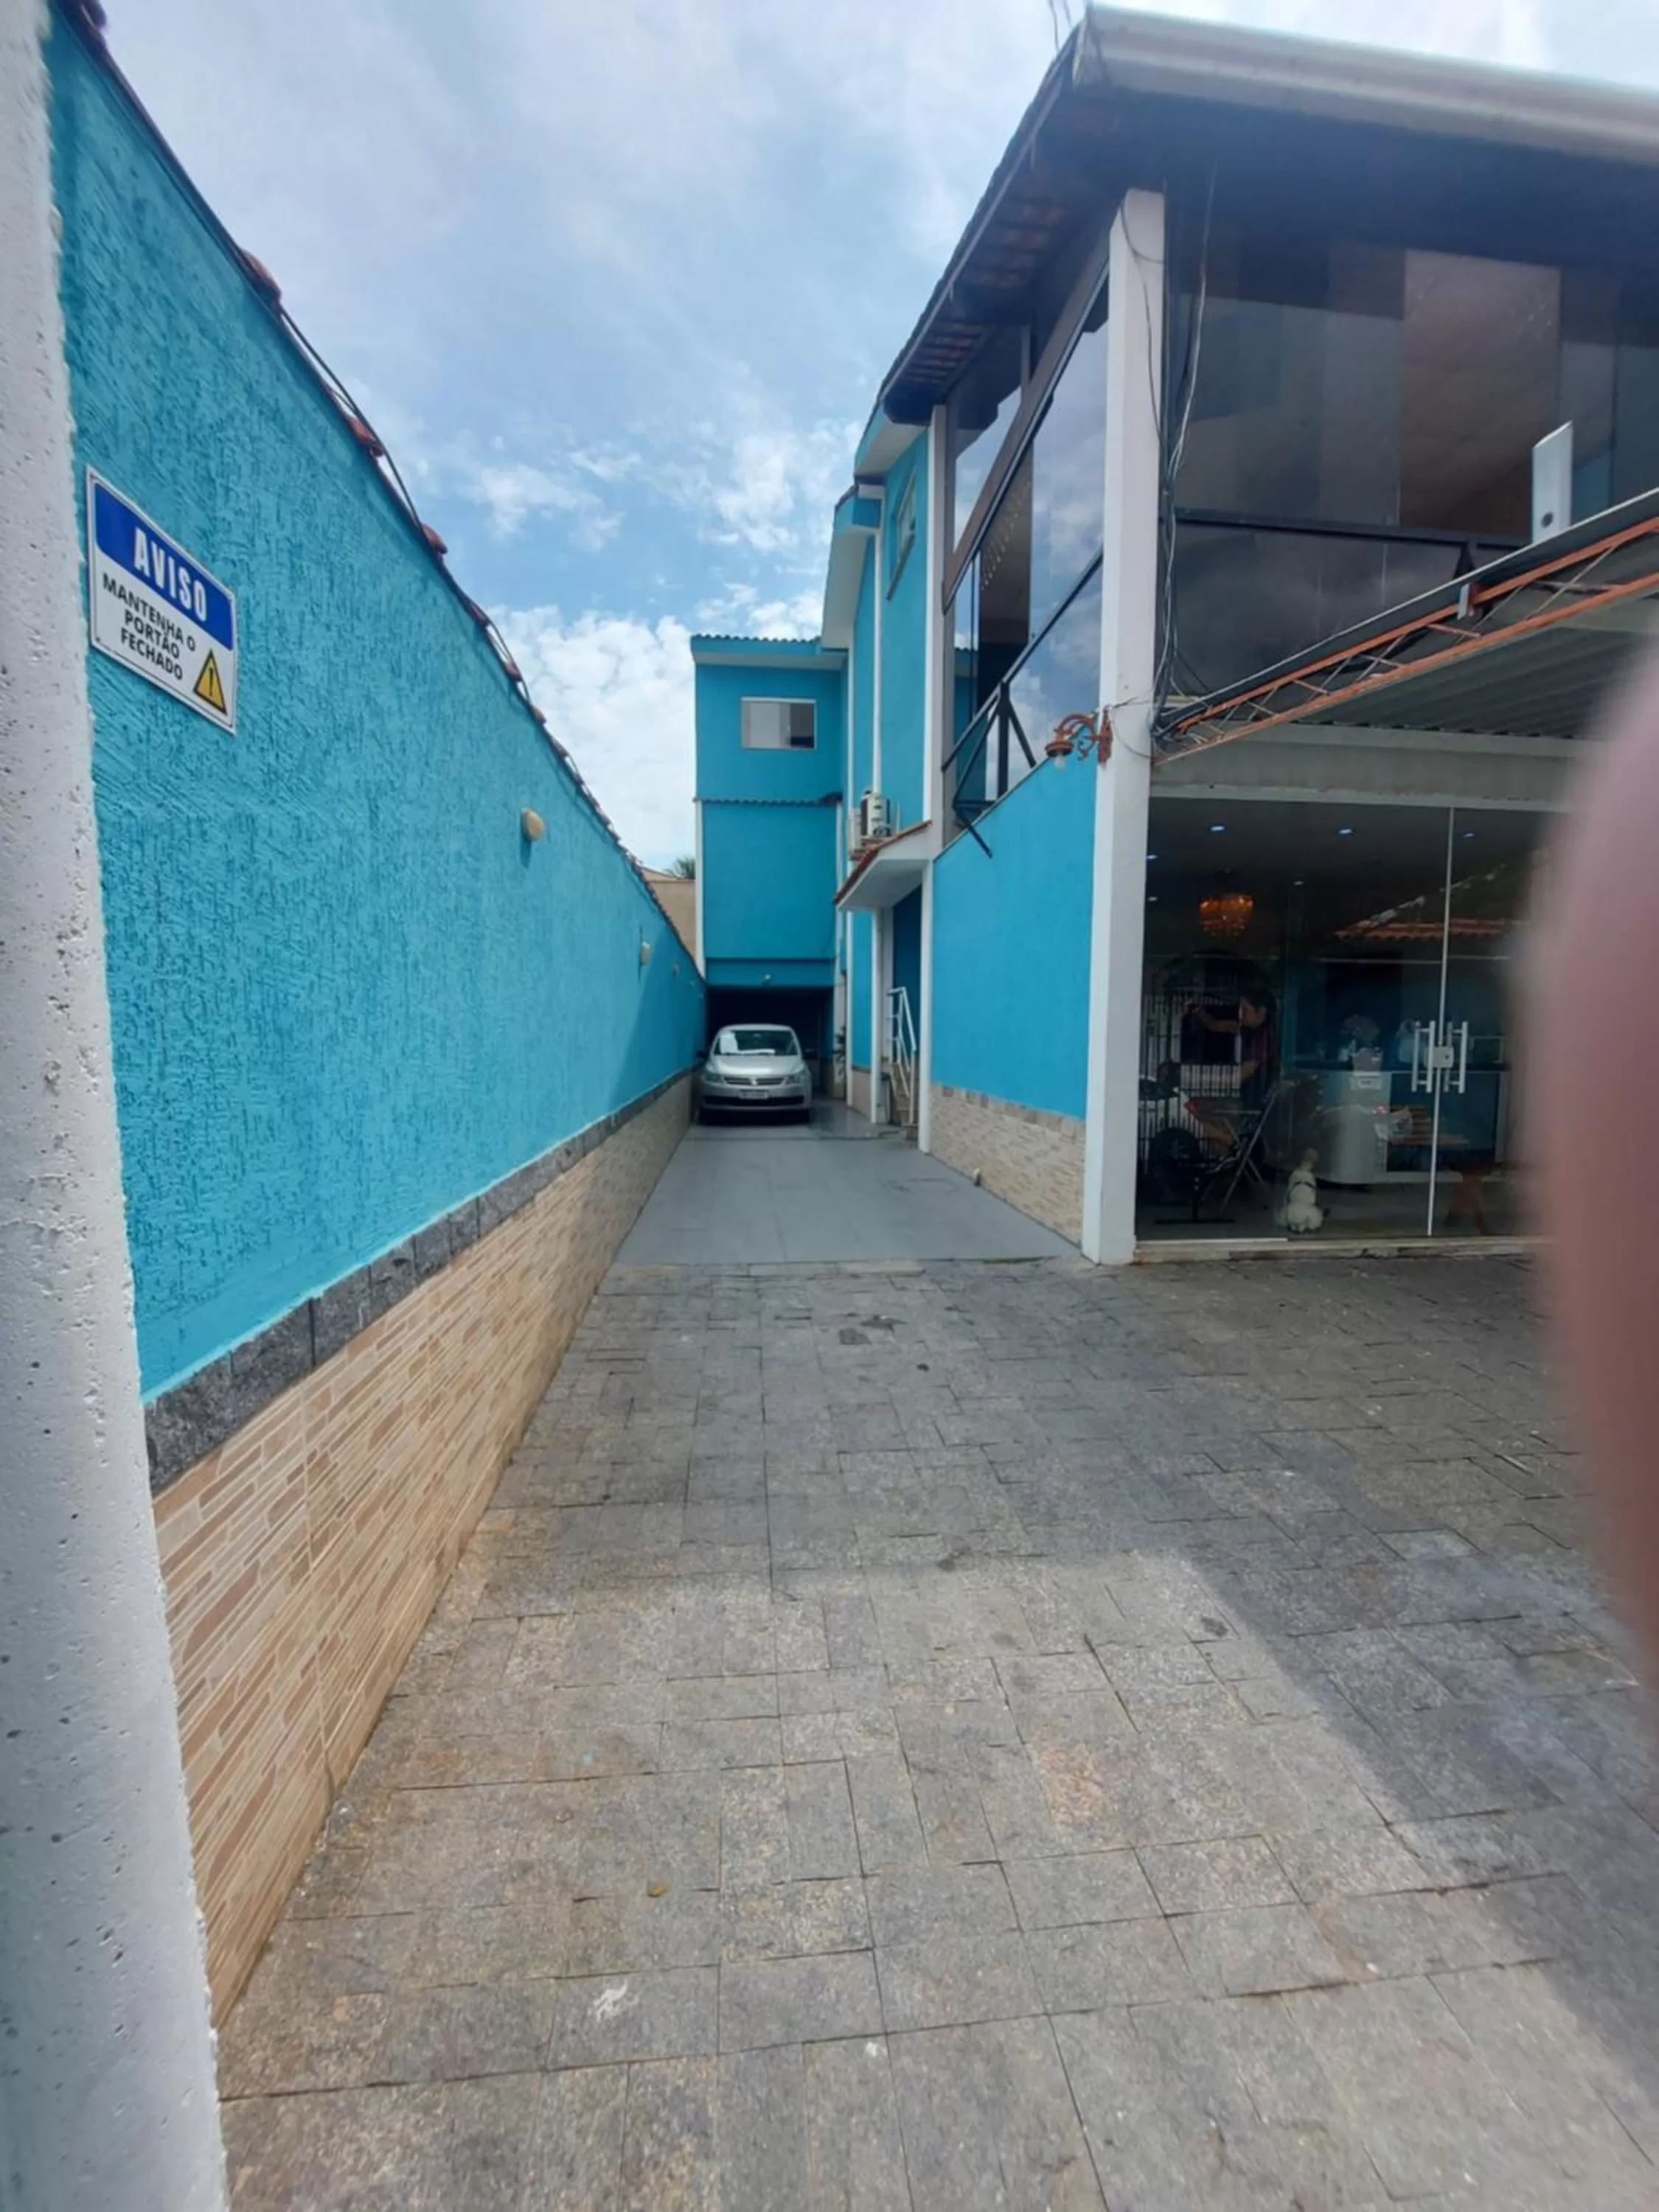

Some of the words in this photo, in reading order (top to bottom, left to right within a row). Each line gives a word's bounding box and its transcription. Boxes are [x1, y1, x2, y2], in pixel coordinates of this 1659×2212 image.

[133, 526, 207, 622] AVISO
[102, 572, 184, 644] MANTENHA
[187, 634, 195, 652] O
[125, 609, 180, 660] PORTÃO
[120, 628, 183, 681] FECHADO
